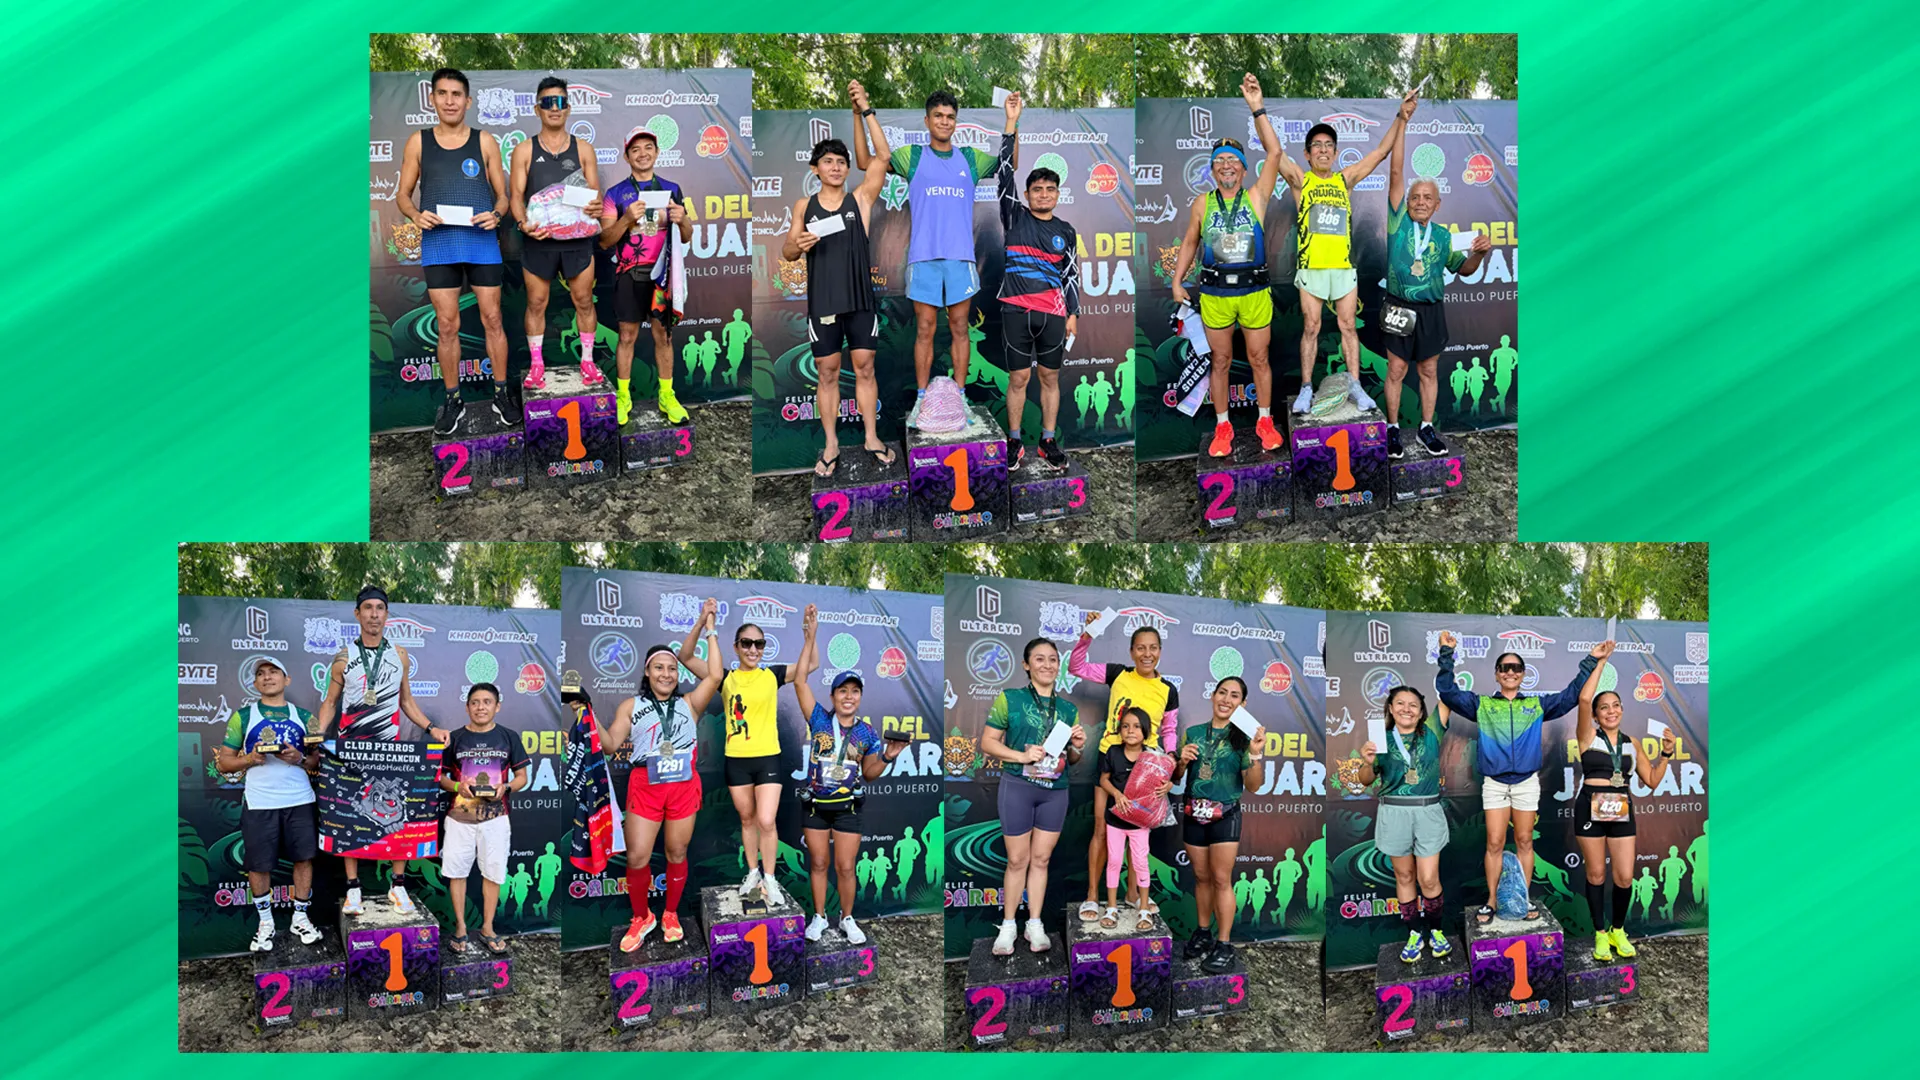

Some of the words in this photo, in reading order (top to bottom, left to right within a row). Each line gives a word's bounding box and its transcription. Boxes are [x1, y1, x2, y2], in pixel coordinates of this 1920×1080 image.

[514, 94, 535, 105] HIEL
[407, 114, 440, 124] ULTRA
[926, 186, 964, 198] VENTUS
[1317, 213, 1340, 226] 806
[1385, 313, 1408, 328] 803
[401, 357, 494, 382] CARILLO
[404, 356, 437, 364] FELIPE
[1091, 357, 1114, 365] Puerto
[556, 401, 587, 460] 1
[675, 429, 693, 457] 3
[438, 443, 472, 488] 2
[1326, 429, 1356, 491] 1
[944, 448, 975, 511] 1
[1445, 459, 1463, 487] 3
[1068, 478, 1086, 508] 3
[1202, 473, 1237, 520] 2
[817, 492, 852, 541] 2
[341, 625, 360, 636] HIEL
[583, 615, 642, 627] ULTRAGYM
[961, 621, 1021, 634] ULTRAGYM
[1462, 637, 1489, 648] HIELO
[1356, 653, 1410, 662] ULTRAGYM
[968, 683, 1003, 695] Fundaci
[339, 751, 385, 761] SALVAJES
[386, 753, 420, 763] CANCUN
[345, 741, 373, 751] CLUB
[375, 743, 415, 752] PERROS
[1264, 732, 1315, 758] DEL
[657, 758, 684, 774] 1291
[897, 783, 939, 794] PUERTO
[1278, 803, 1323, 813] PUERTO
[1600, 801, 1622, 812] 420
[1659, 802, 1702, 813] PUERTO
[945, 881, 974, 889] ELIPE
[1344, 892, 1377, 901] FELIPE
[379, 932, 408, 991] 1
[744, 923, 773, 985] 1
[858, 948, 874, 976] 3
[493, 961, 510, 989] 3
[1106, 943, 1136, 1007] 1
[1503, 939, 1533, 1000] 1
[1619, 965, 1636, 994] 3
[260, 973, 293, 1017] 2
[616, 971, 652, 1019] 2
[1228, 975, 1245, 1004] 3
[971, 987, 1007, 1036] 2
[1381, 985, 1416, 1032] 2
